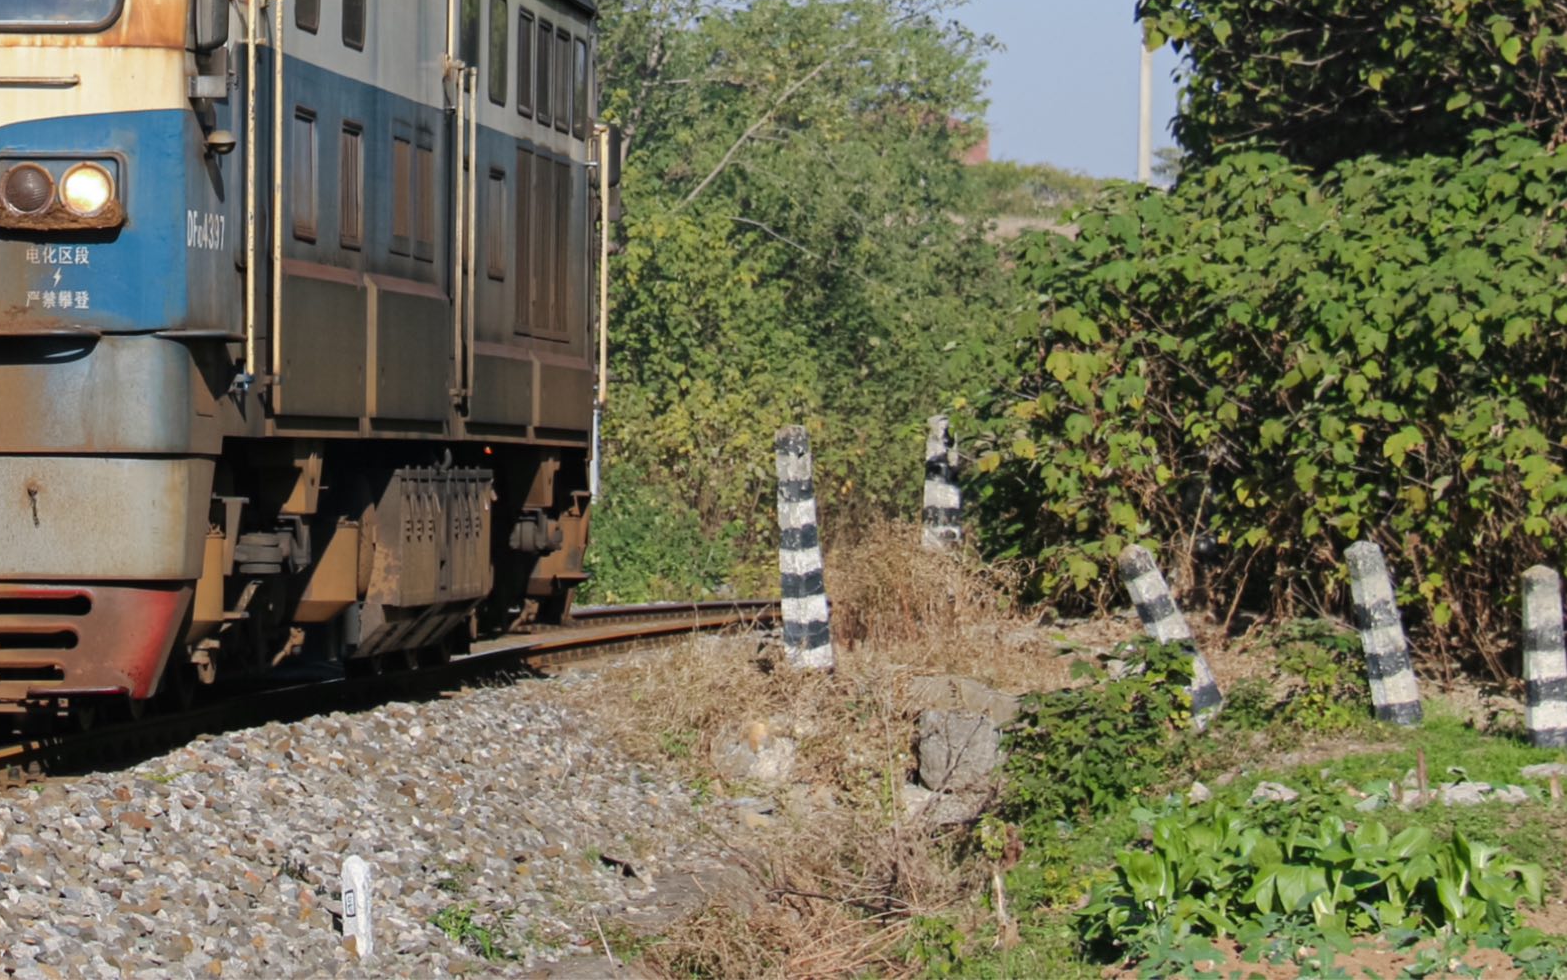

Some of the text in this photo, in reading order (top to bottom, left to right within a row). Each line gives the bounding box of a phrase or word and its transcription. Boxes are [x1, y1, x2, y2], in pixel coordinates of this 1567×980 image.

[26, 246, 90, 264] 电化区段
[25, 290, 90, 309] 严禁攀登
